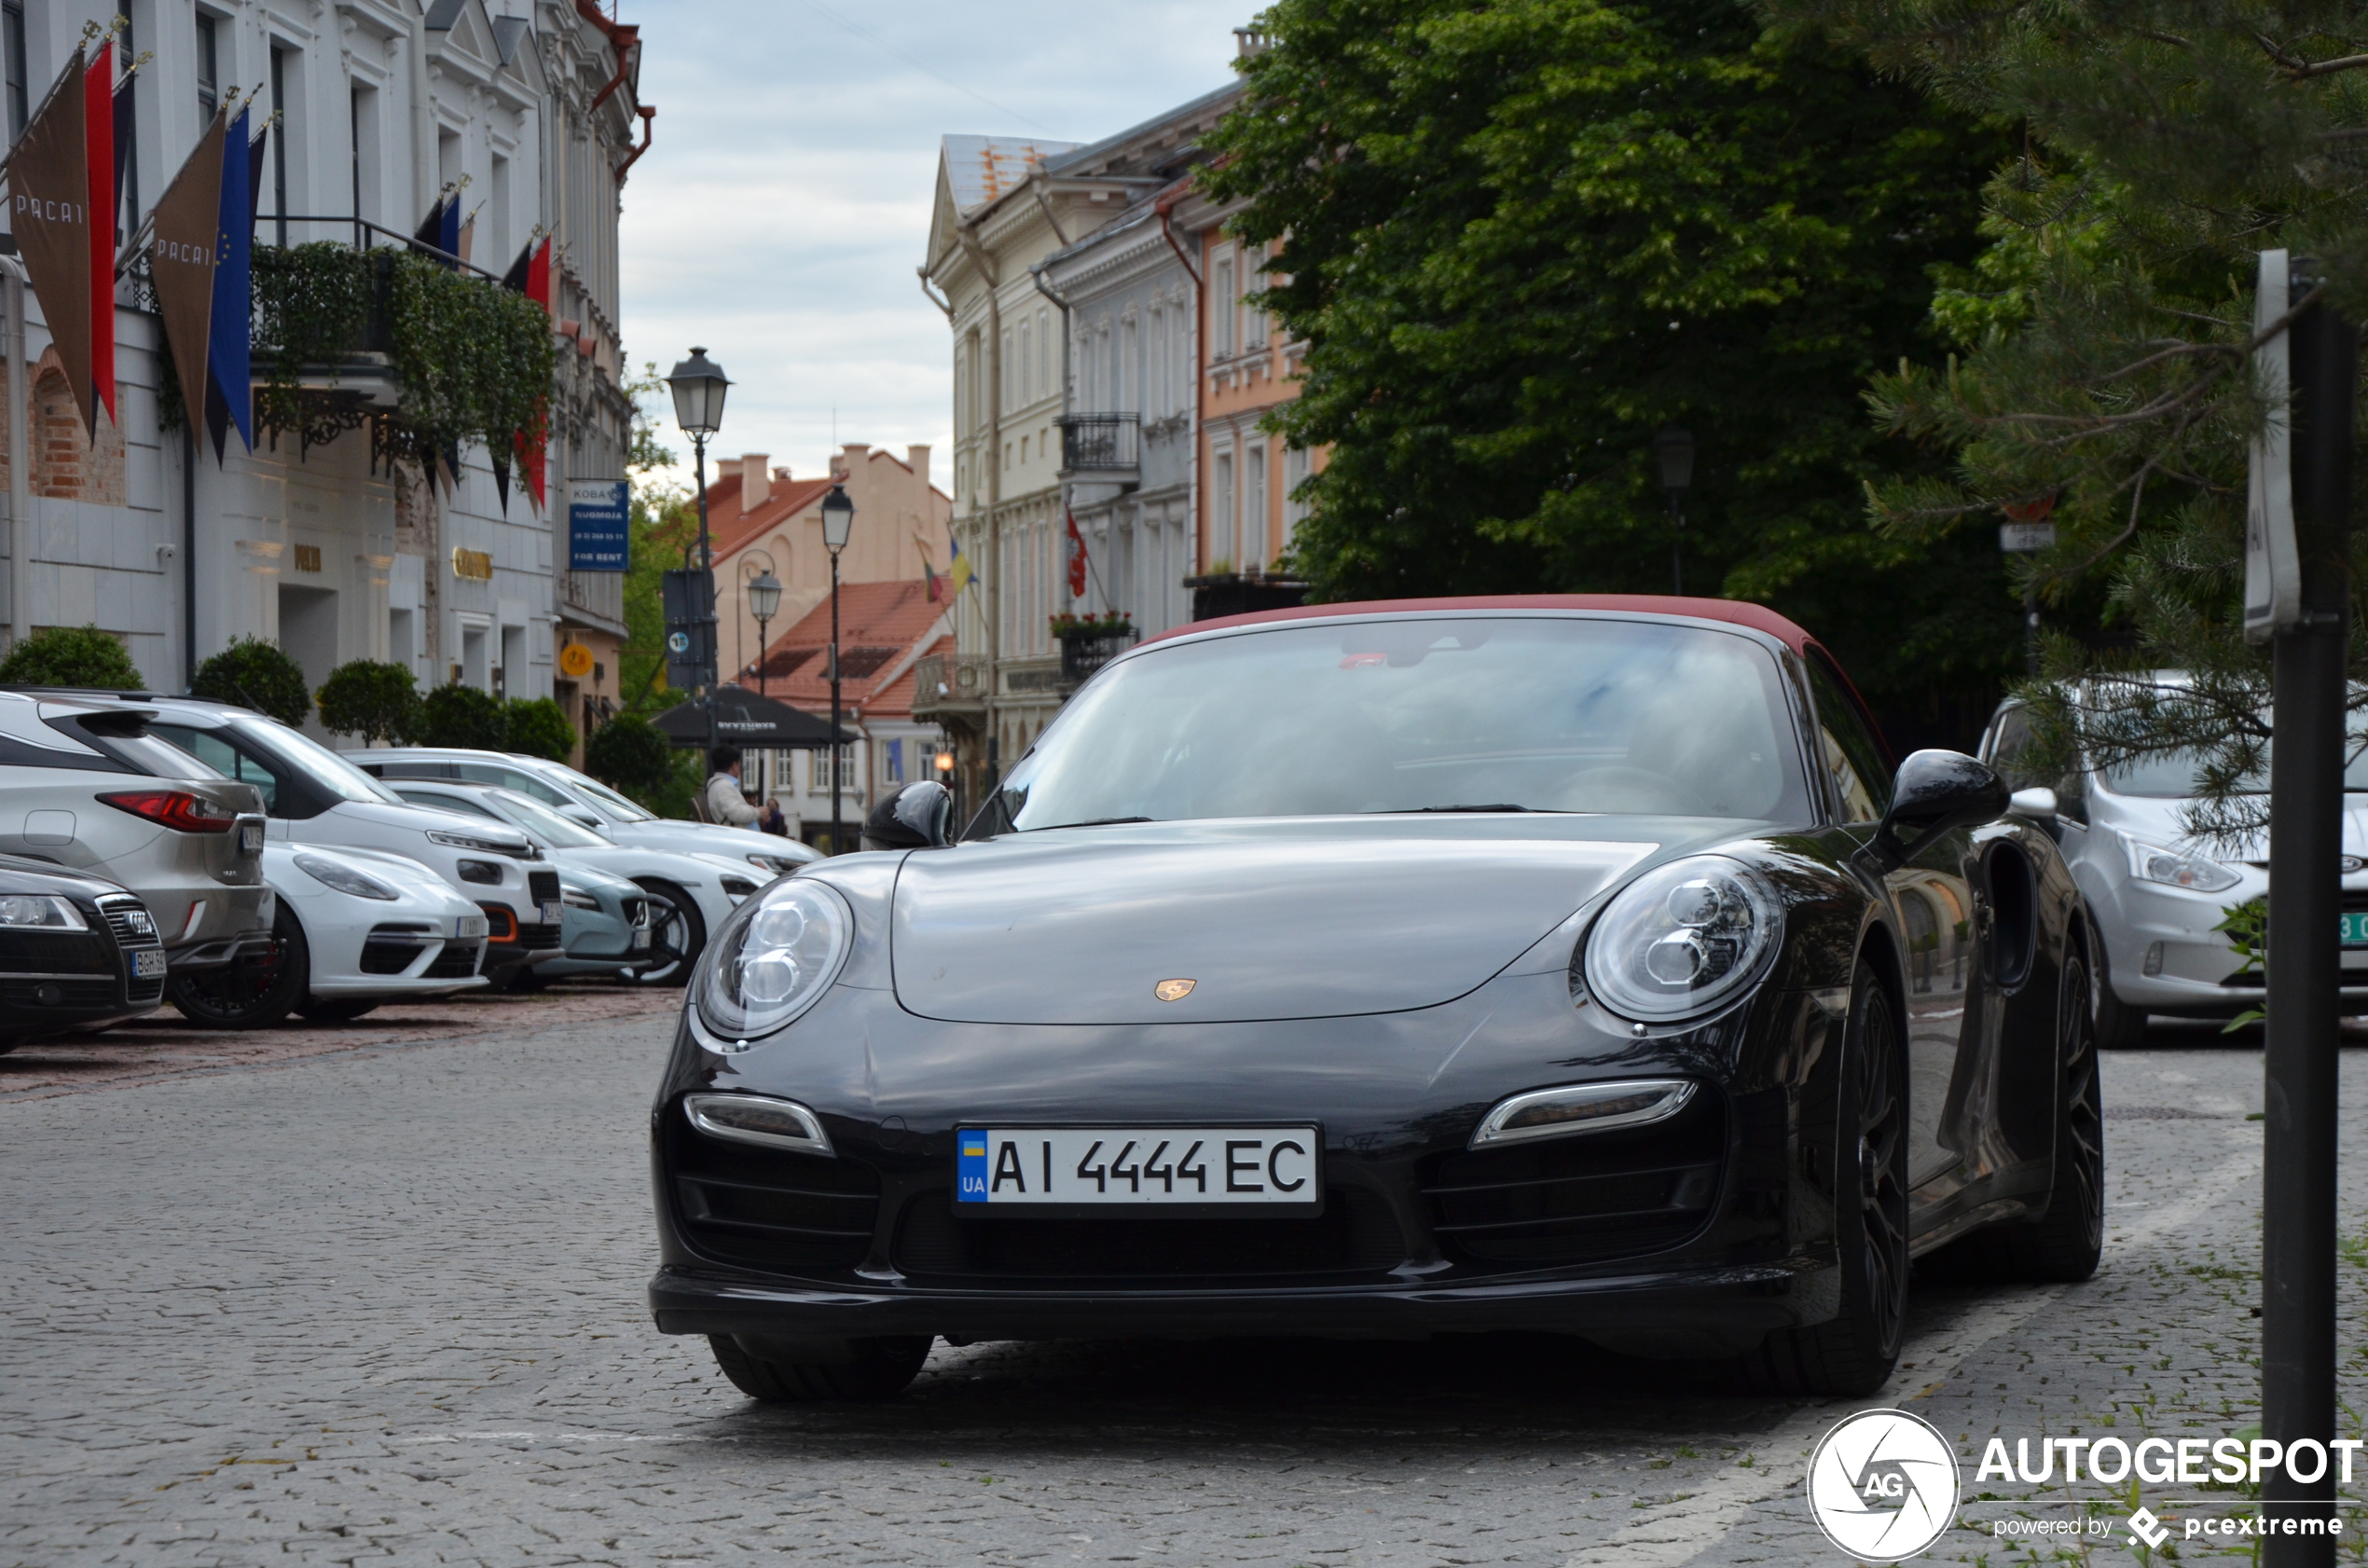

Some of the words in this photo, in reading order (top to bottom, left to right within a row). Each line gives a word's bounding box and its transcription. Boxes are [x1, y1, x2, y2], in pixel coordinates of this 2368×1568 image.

[17, 195, 82, 224] PACAI
[158, 239, 210, 266] PACAI
[573, 489, 606, 499] KOBA
[574, 553, 593, 561] FOR
[596, 553, 623, 561] RENT
[1077, 1140, 1205, 1192] 4444
[1226, 1140, 1306, 1192] EC
[963, 1176, 985, 1192] UA
